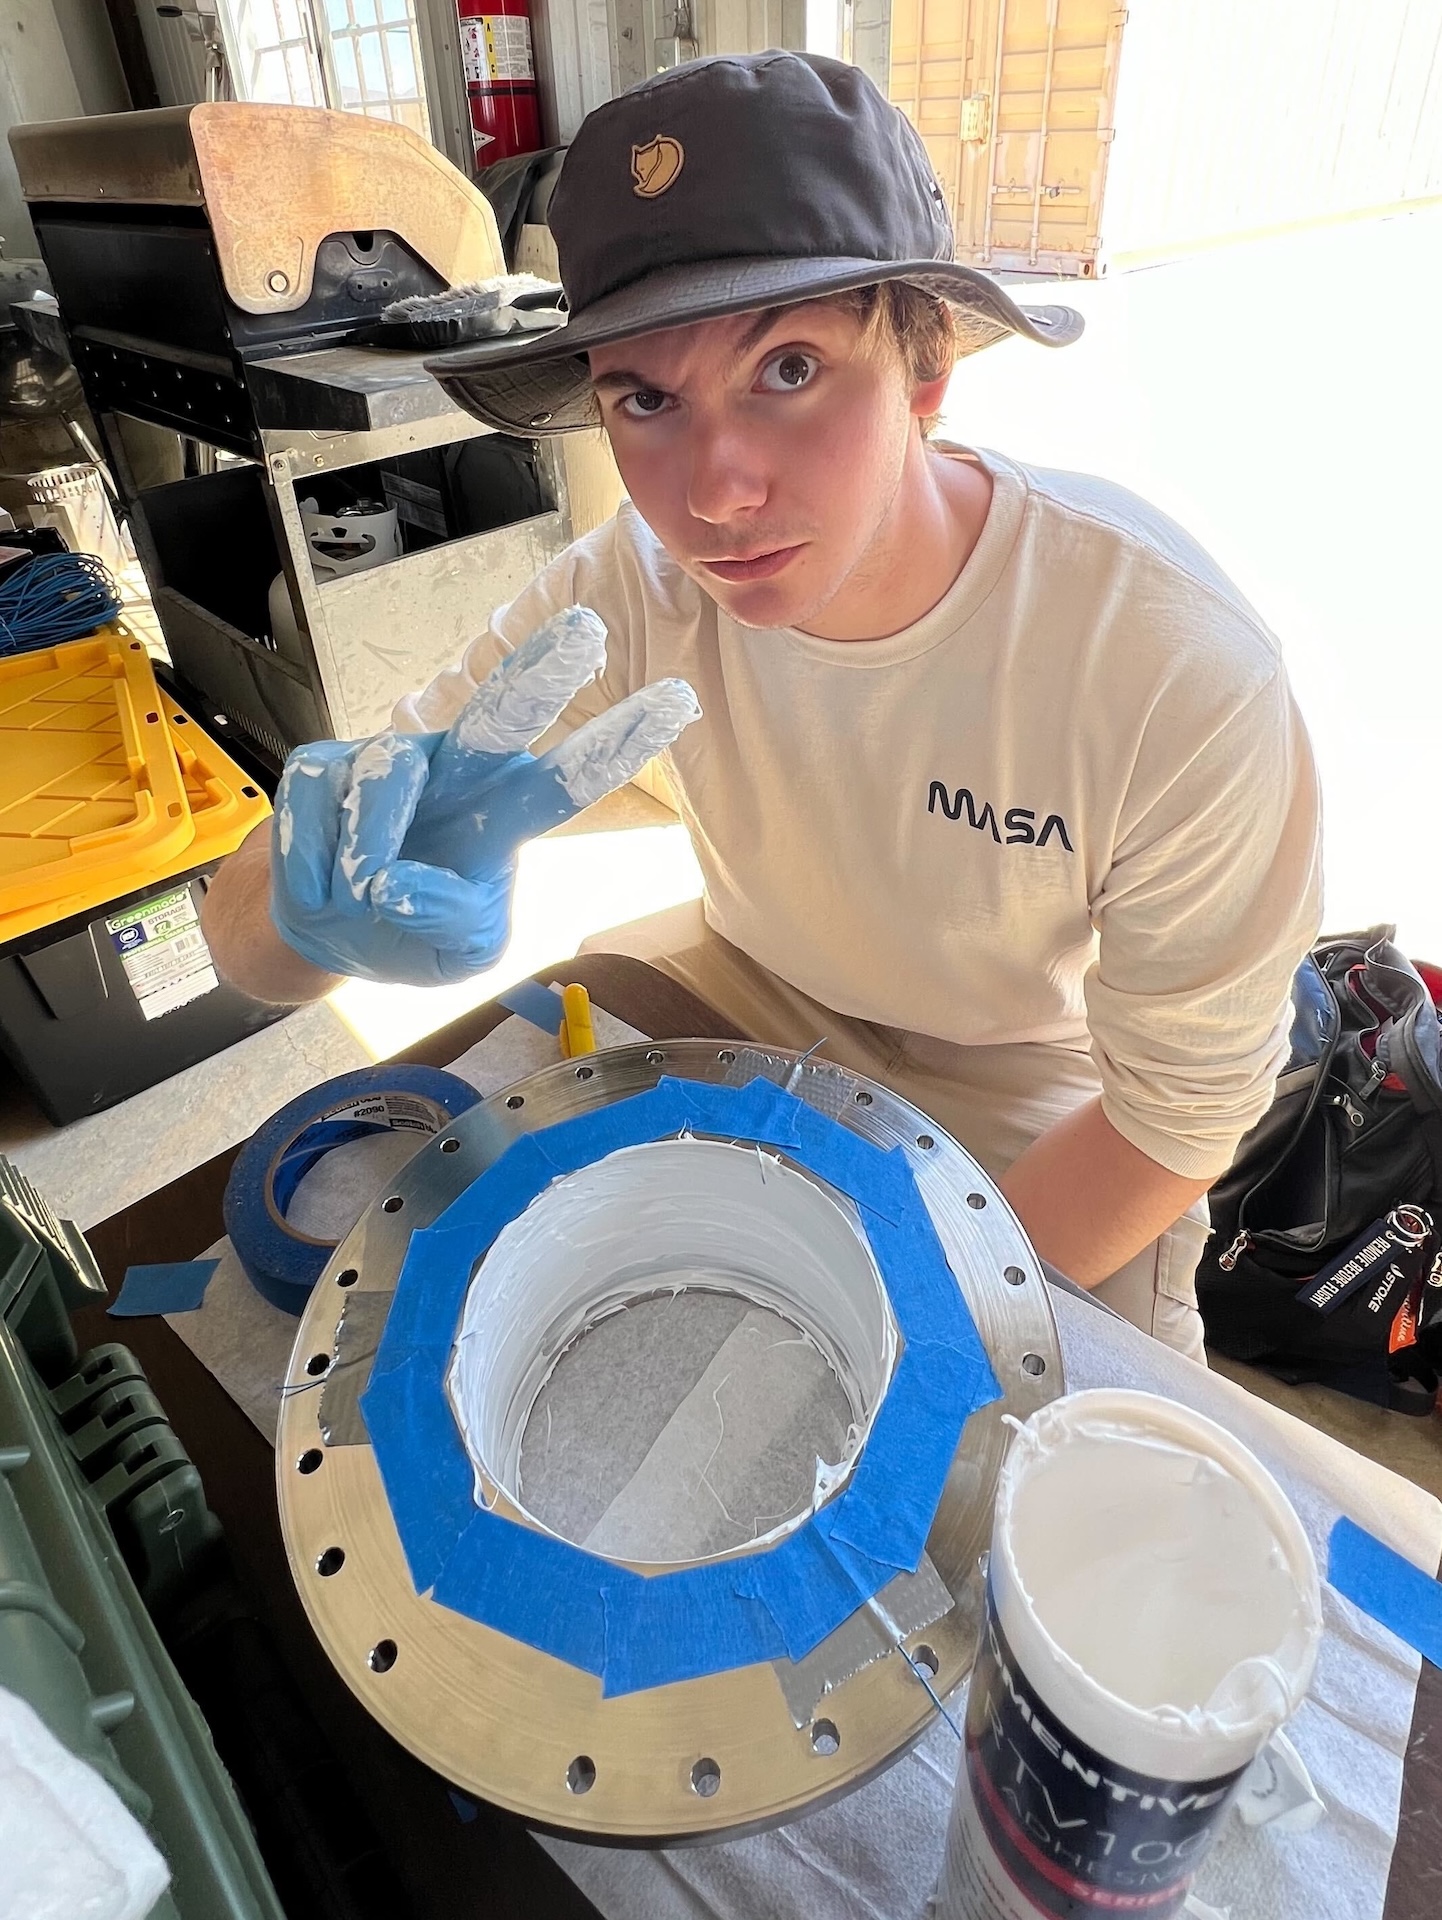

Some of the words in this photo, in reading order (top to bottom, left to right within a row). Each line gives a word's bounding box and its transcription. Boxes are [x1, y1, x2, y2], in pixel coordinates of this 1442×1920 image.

[110, 893, 185, 930] Greenmade
[148, 903, 187, 925] STORAGE
[353, 1105, 385, 1118] #2090
[1358, 1236, 1392, 1268] REMOVE
[1330, 1260, 1364, 1288] BEFORE
[1309, 1281, 1340, 1308] FLIGHT
[1368, 1271, 1396, 1313] STOKE
[986, 1598, 1229, 1817] OMENTIV
